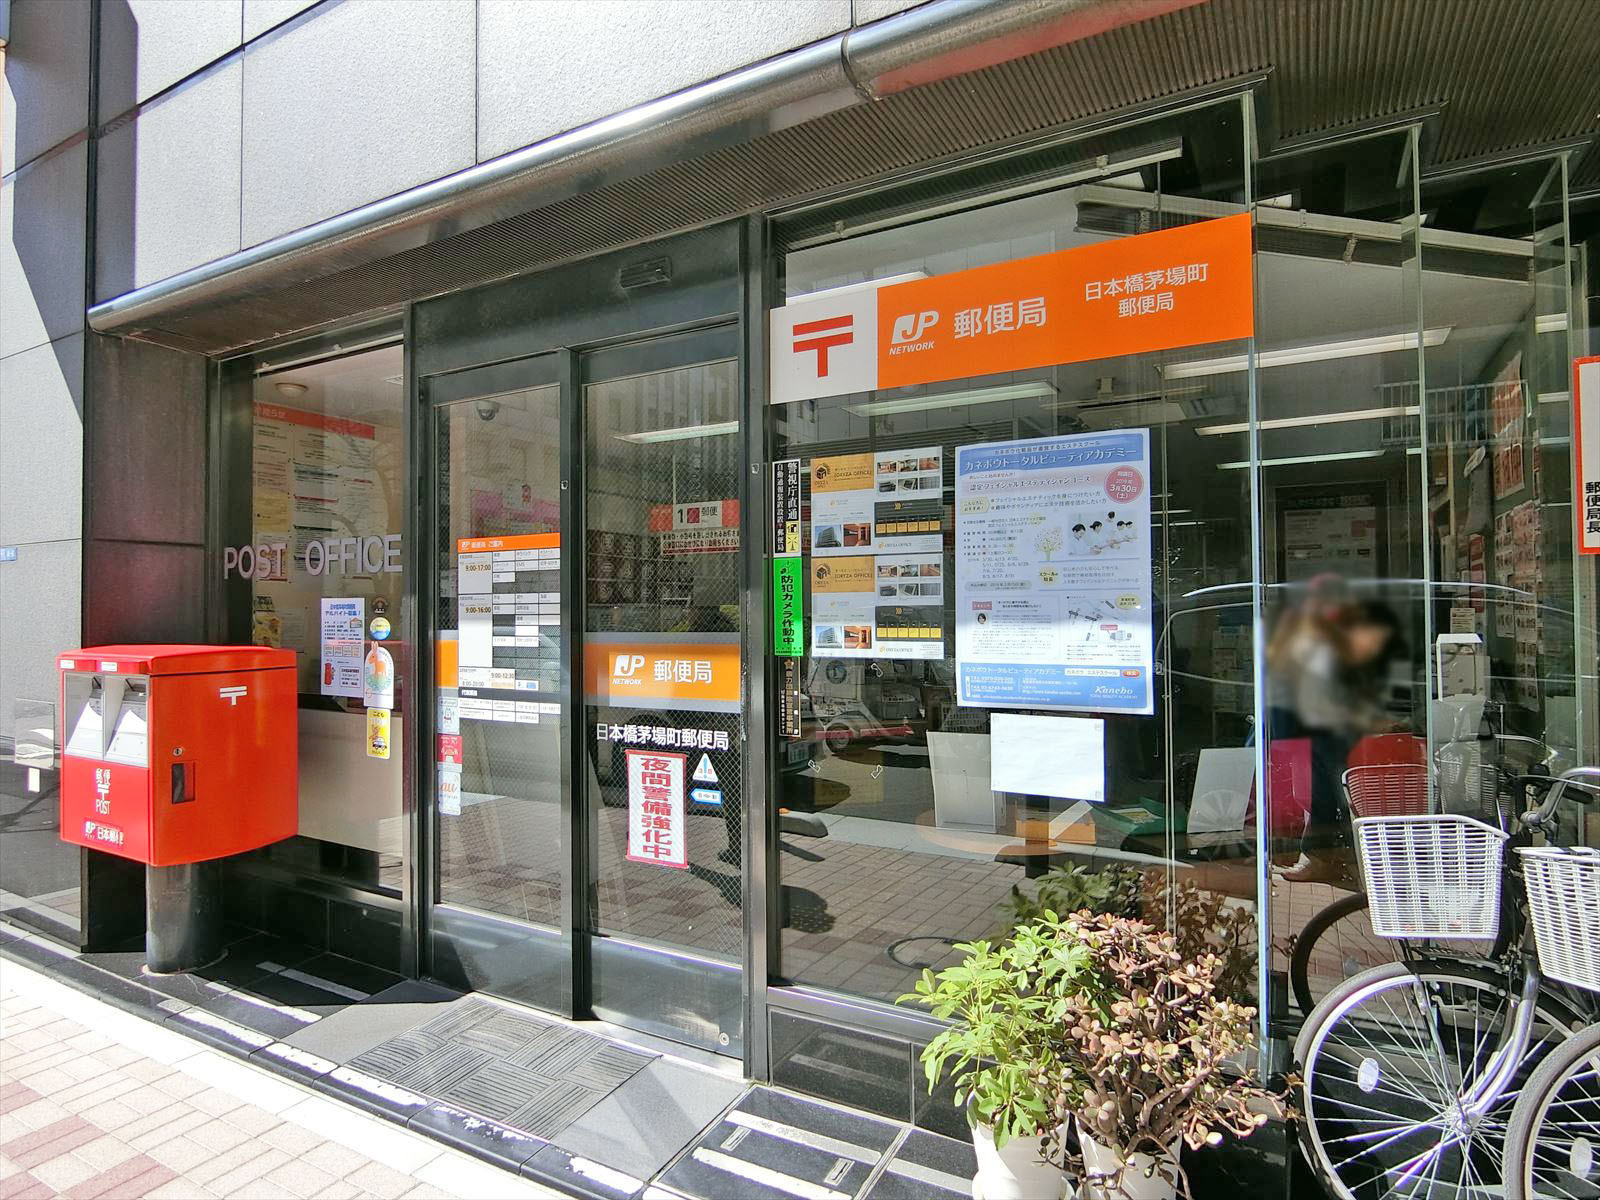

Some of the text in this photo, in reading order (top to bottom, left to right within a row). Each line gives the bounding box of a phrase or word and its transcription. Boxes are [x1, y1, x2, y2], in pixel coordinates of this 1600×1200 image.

[1084, 263, 1209, 301] 日本橋茅場町
[1117, 291, 1174, 318] 郵便局
[953, 296, 1047, 340] 郵便局
[889, 340, 935, 356] NETWORK
[965, 447, 1137, 471] カネボウトータルビューティアカデミー
[787, 462, 798, 519] 警視庁直通
[1109, 484, 1137, 493] 3月30日
[677, 508, 684, 523] 1
[223, 534, 404, 580] POST OFFICE
[781, 575, 795, 646] 防犯カメラ作動中
[612, 678, 643, 686] NETWORK
[653, 659, 713, 684] 郵便局
[1094, 684, 1134, 695] Kanebo
[596, 722, 729, 750] 日本橋茅場町郵便局
[95, 767, 111, 785] 郵便
[95, 798, 111, 815] POST
[640, 757, 672, 859] 夜間警備強化中
